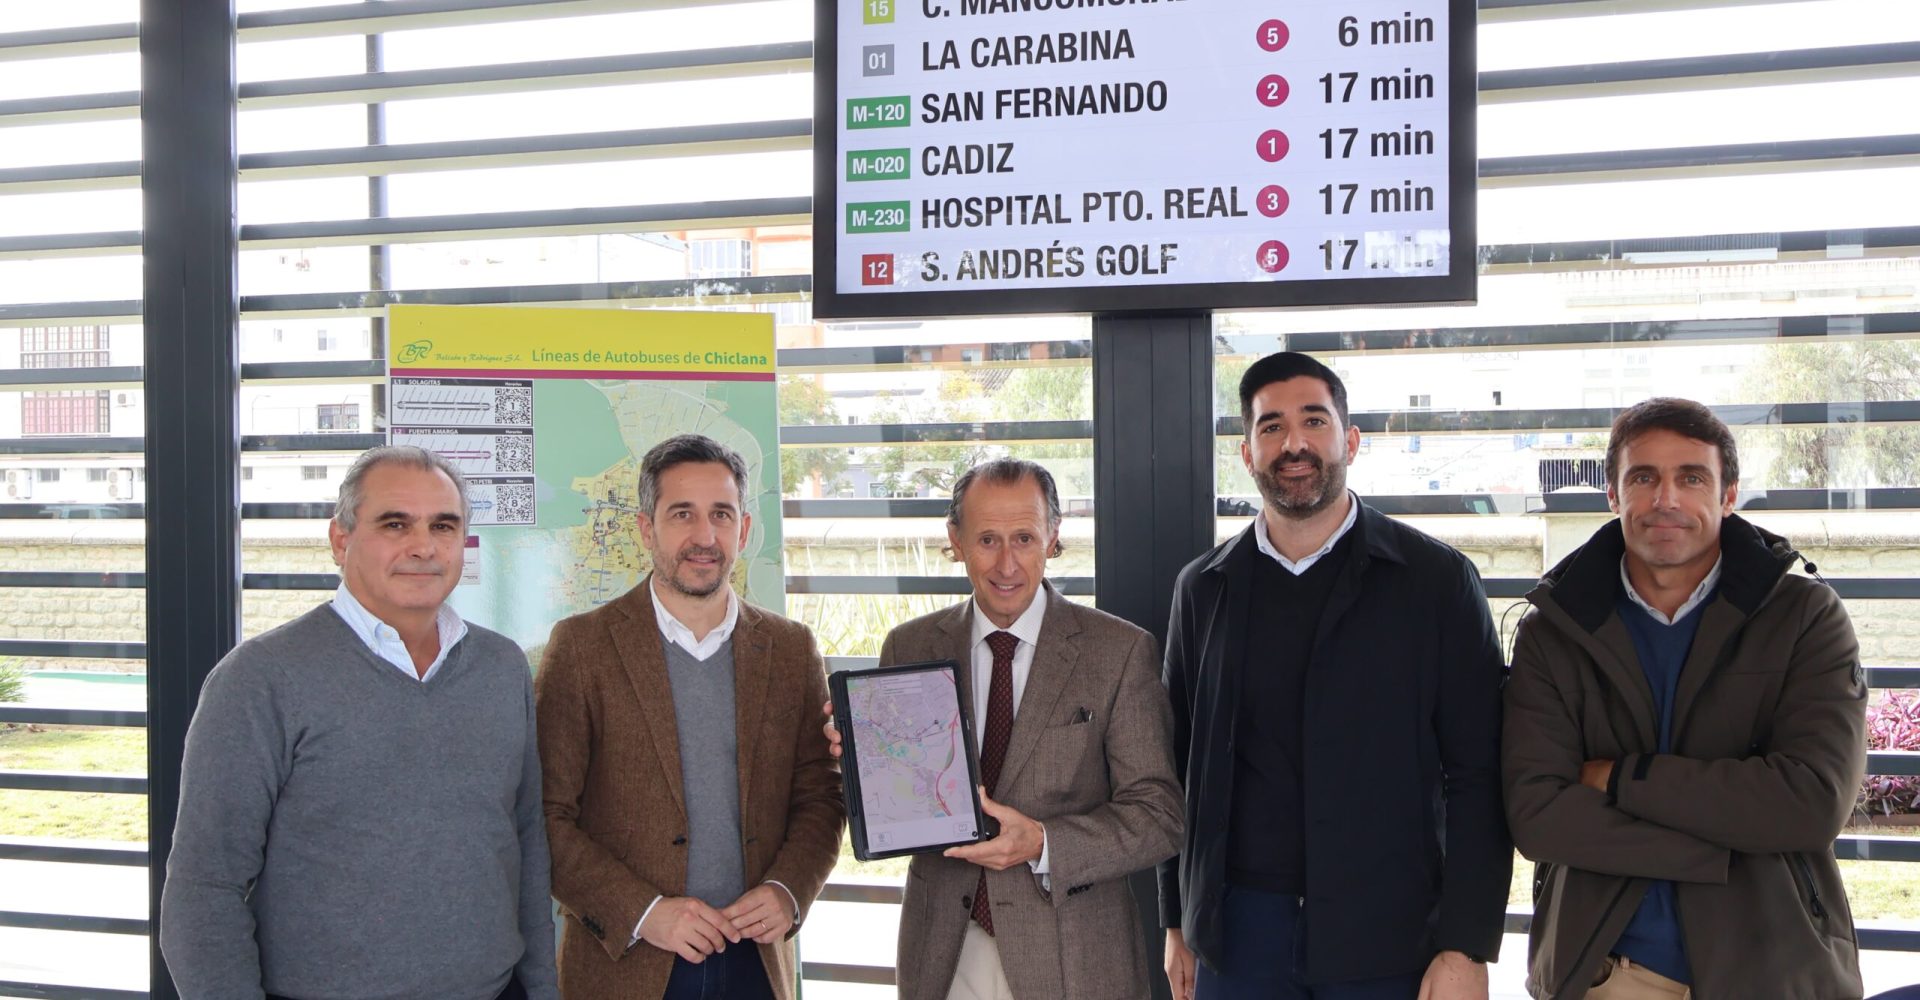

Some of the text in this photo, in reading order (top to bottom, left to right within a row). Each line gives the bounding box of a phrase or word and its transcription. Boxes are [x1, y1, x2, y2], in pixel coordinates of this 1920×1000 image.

[869, 0, 889, 17] 15
[868, 11, 1434, 71] 01 LA CARABINA 5 6 min
[852, 67, 1434, 124] M-120 SAN FERNANDO 2 17 min
[852, 123, 1434, 176] M-020 CADIZ 1 17 min
[852, 180, 1434, 229] M-230 HOSPITAL PTO. REAL 3 17 min
[868, 261, 888, 279] 12
[921, 251, 949, 282] S.
[956, 240, 1085, 281] ANDRÉS
[1096, 243, 1178, 276] GOLF
[1266, 248, 1279, 266] 5
[1318, 239, 1359, 271] 17
[531, 348, 767, 365] Líneas de Autobuses de Chiclana
[408, 428, 431, 436] FUENTE
[432, 428, 458, 436] AMARGA
[510, 450, 517, 458] 2
[511, 499, 518, 507] 8
